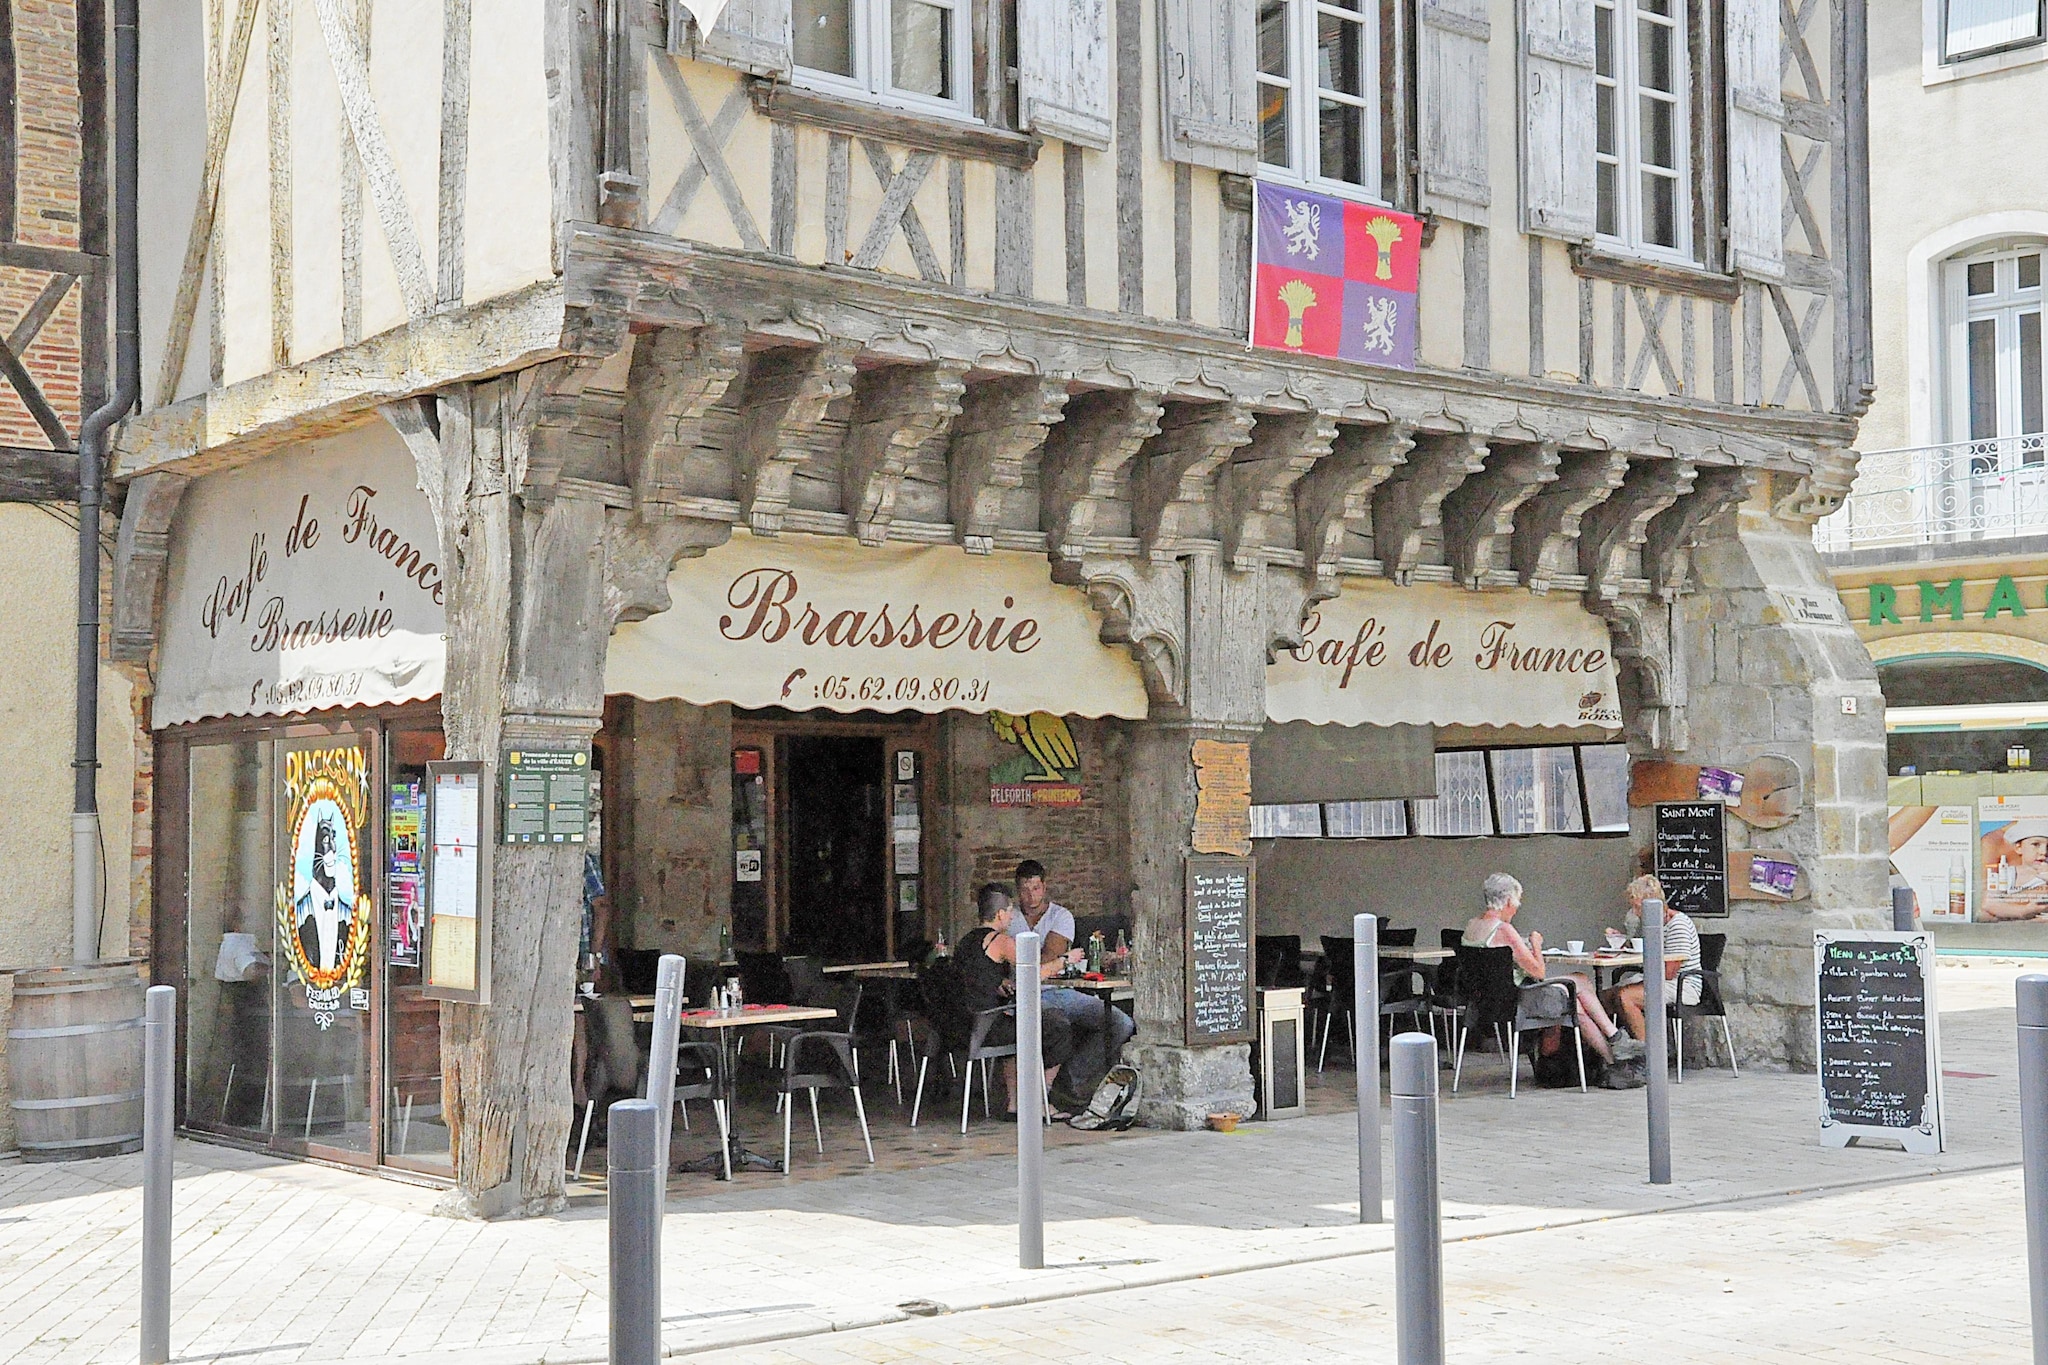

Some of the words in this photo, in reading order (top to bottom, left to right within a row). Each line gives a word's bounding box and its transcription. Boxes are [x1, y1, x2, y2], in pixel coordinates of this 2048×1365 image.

[203, 532, 268, 638] Café
[285, 494, 320, 558] de
[251, 590, 394, 652] Brasserie
[719, 568, 1041, 654] Brasserie
[1868, 574, 2048, 627] RMA
[1290, 611, 1387, 689] Café
[1407, 619, 1454, 668] de
[1475, 621, 1607, 673] France
[1846, 700, 1852, 711] 2
[990, 788, 1032, 803] PELFORTH
[1829, 947, 1853, 959] MENU
